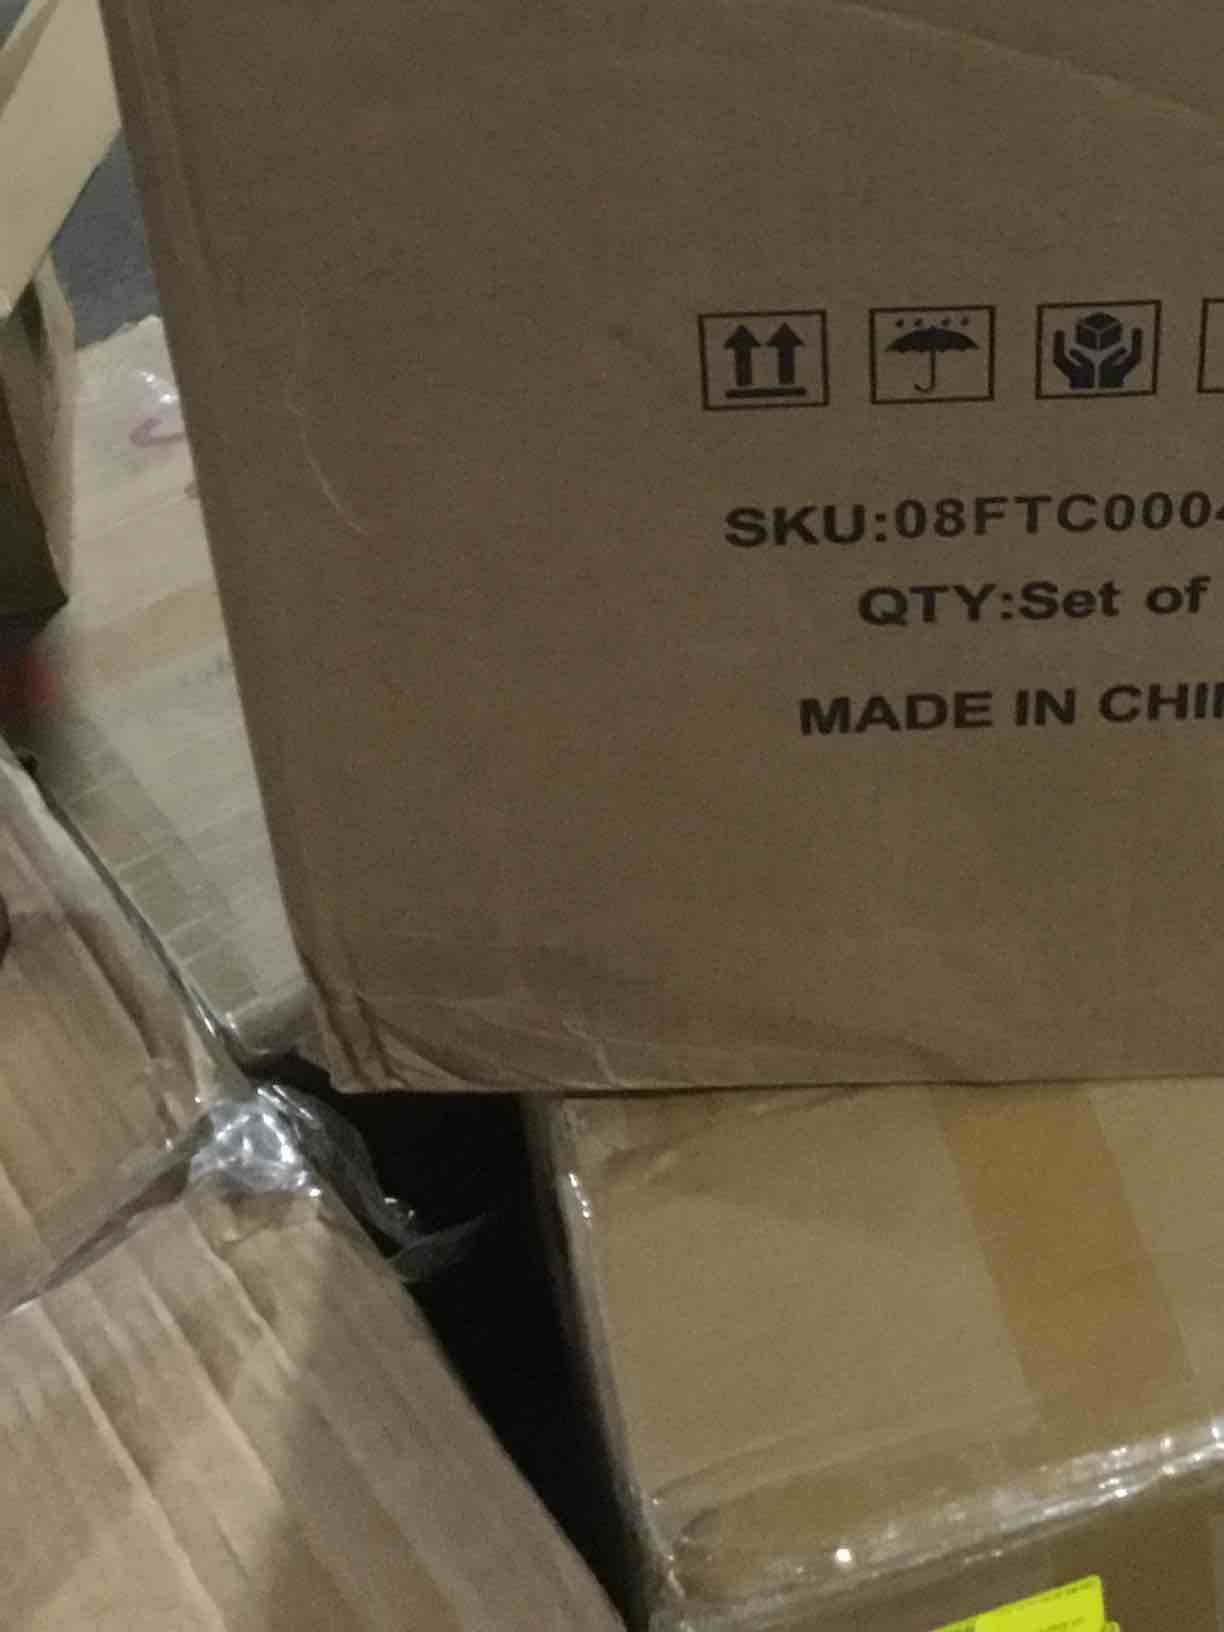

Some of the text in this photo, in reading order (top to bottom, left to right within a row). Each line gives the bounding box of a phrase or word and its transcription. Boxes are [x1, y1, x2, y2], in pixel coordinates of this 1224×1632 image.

[857, 580, 1121, 627] QTY:Set
[1144, 575, 1211, 616] of
[800, 690, 994, 737] MADE
[1014, 687, 1077, 726] IN
